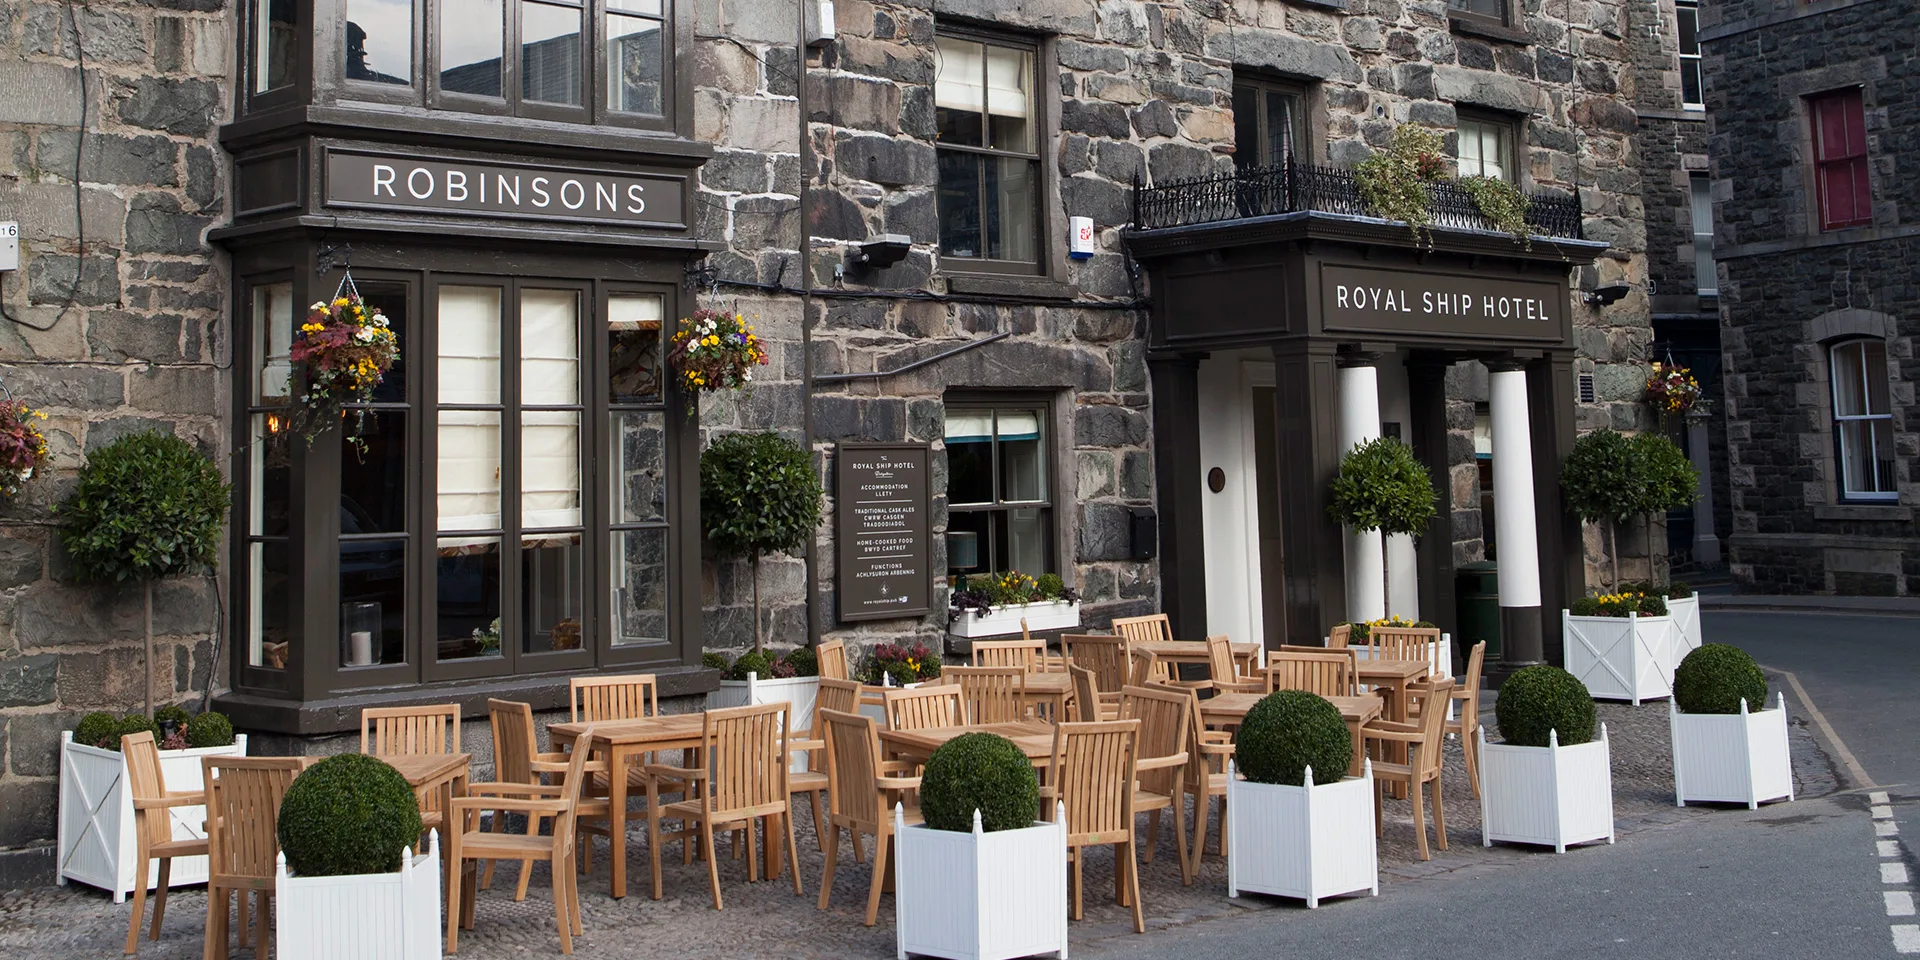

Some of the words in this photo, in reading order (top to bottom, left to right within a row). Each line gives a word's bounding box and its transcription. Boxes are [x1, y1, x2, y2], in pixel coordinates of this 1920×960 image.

[373, 164, 646, 214] ROBINSONS
[1337, 285, 1411, 312] ROYAL
[1423, 291, 1472, 316] SHIP
[1483, 296, 1549, 320] HOTEL
[855, 570, 889, 578] ACHLYSURON
[889, 569, 915, 577] ARBENNIG
